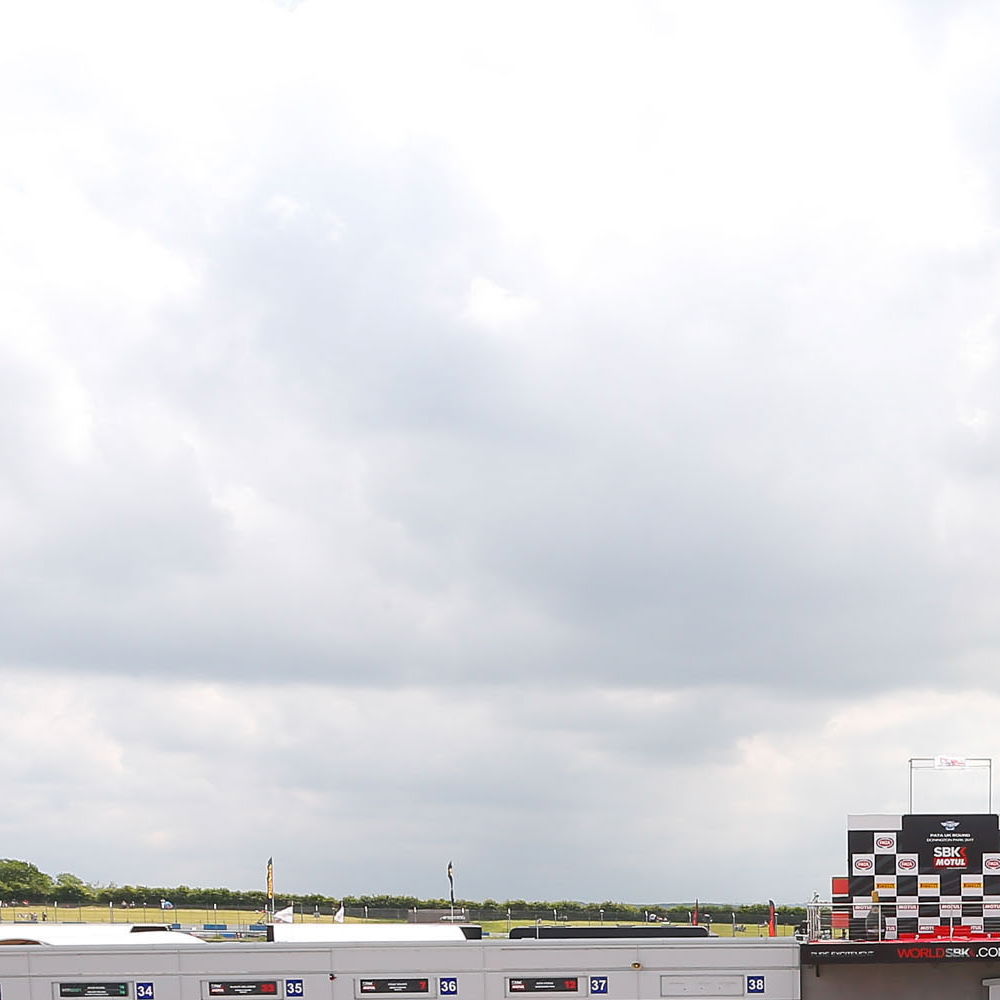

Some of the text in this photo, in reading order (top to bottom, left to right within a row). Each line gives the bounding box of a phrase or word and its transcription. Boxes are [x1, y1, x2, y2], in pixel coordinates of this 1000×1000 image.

[934, 847, 960, 857] SBK
[935, 858, 966, 866] MOTUL
[287, 983, 303, 994] 35
[440, 981, 457, 992] 36
[591, 980, 606, 991] 37
[748, 979, 764, 990] 38
[137, 986, 153, 997] 34
